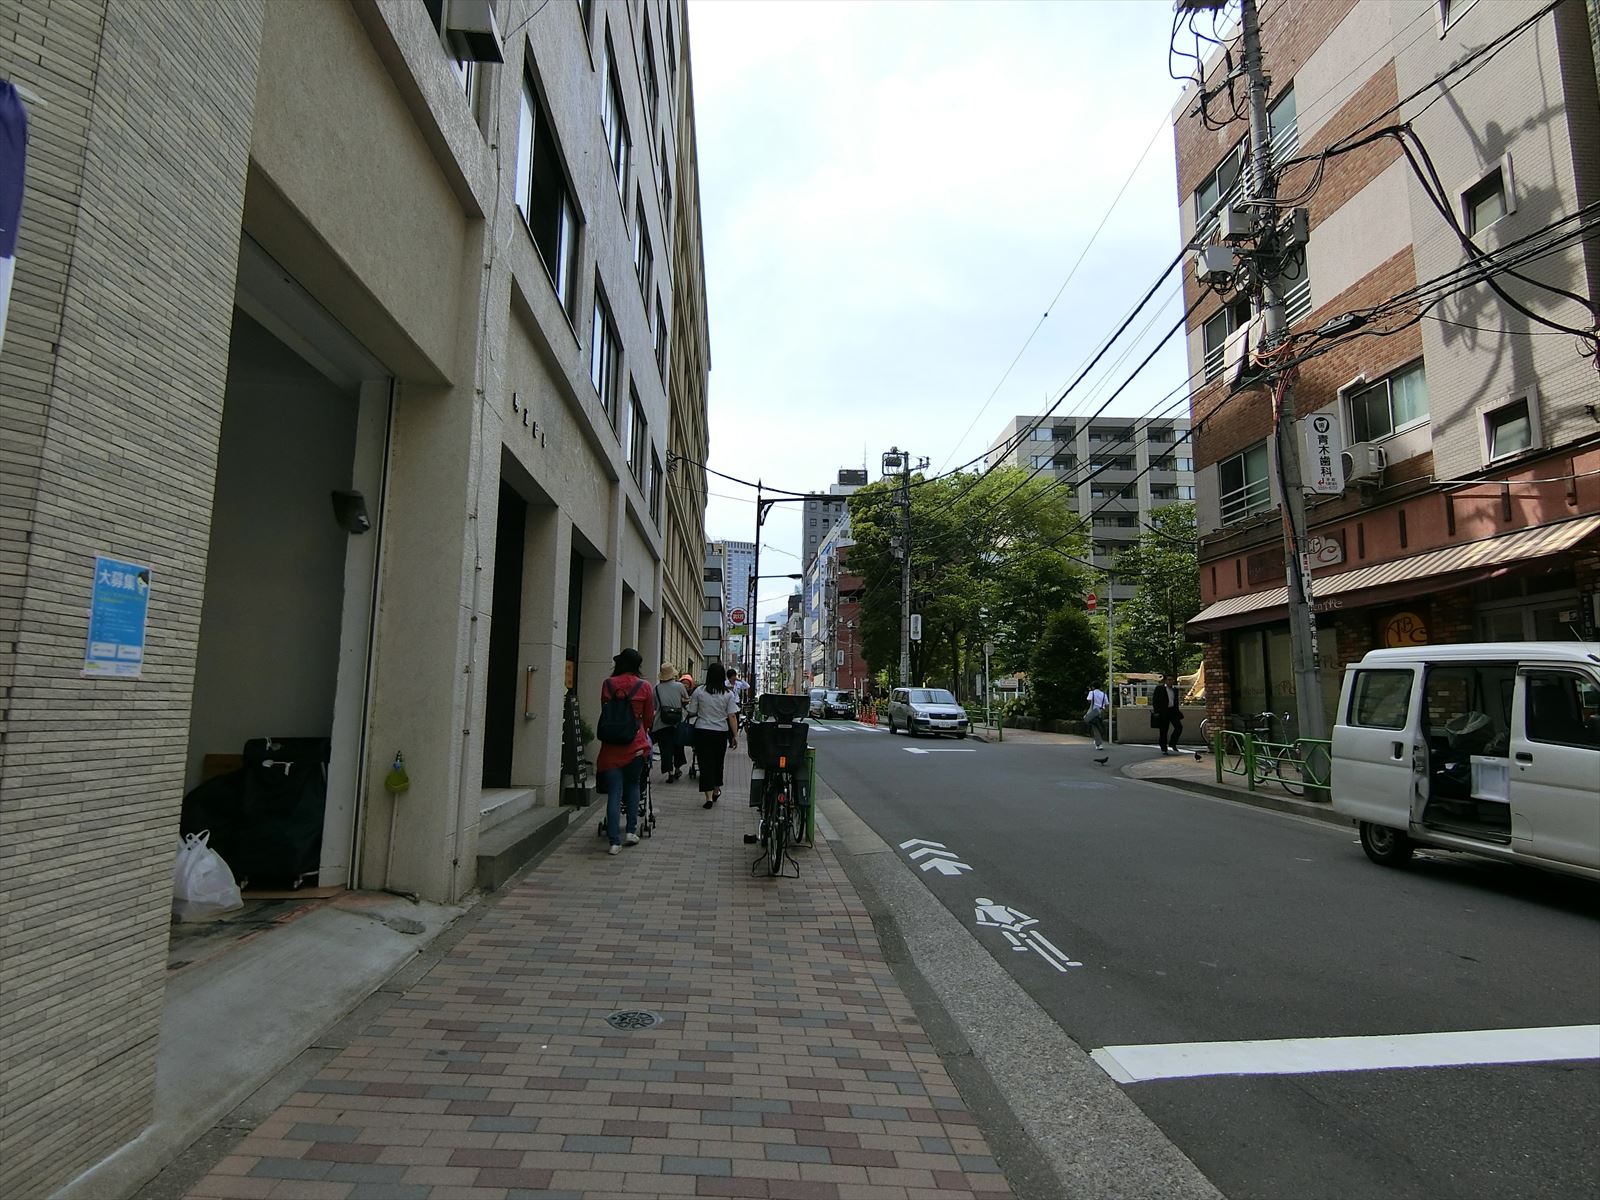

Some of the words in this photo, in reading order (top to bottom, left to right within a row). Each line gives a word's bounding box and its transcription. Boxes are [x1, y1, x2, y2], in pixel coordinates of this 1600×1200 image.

[1317, 434, 1333, 477] 青木歯科
[97, 568, 136, 591] 大募集
